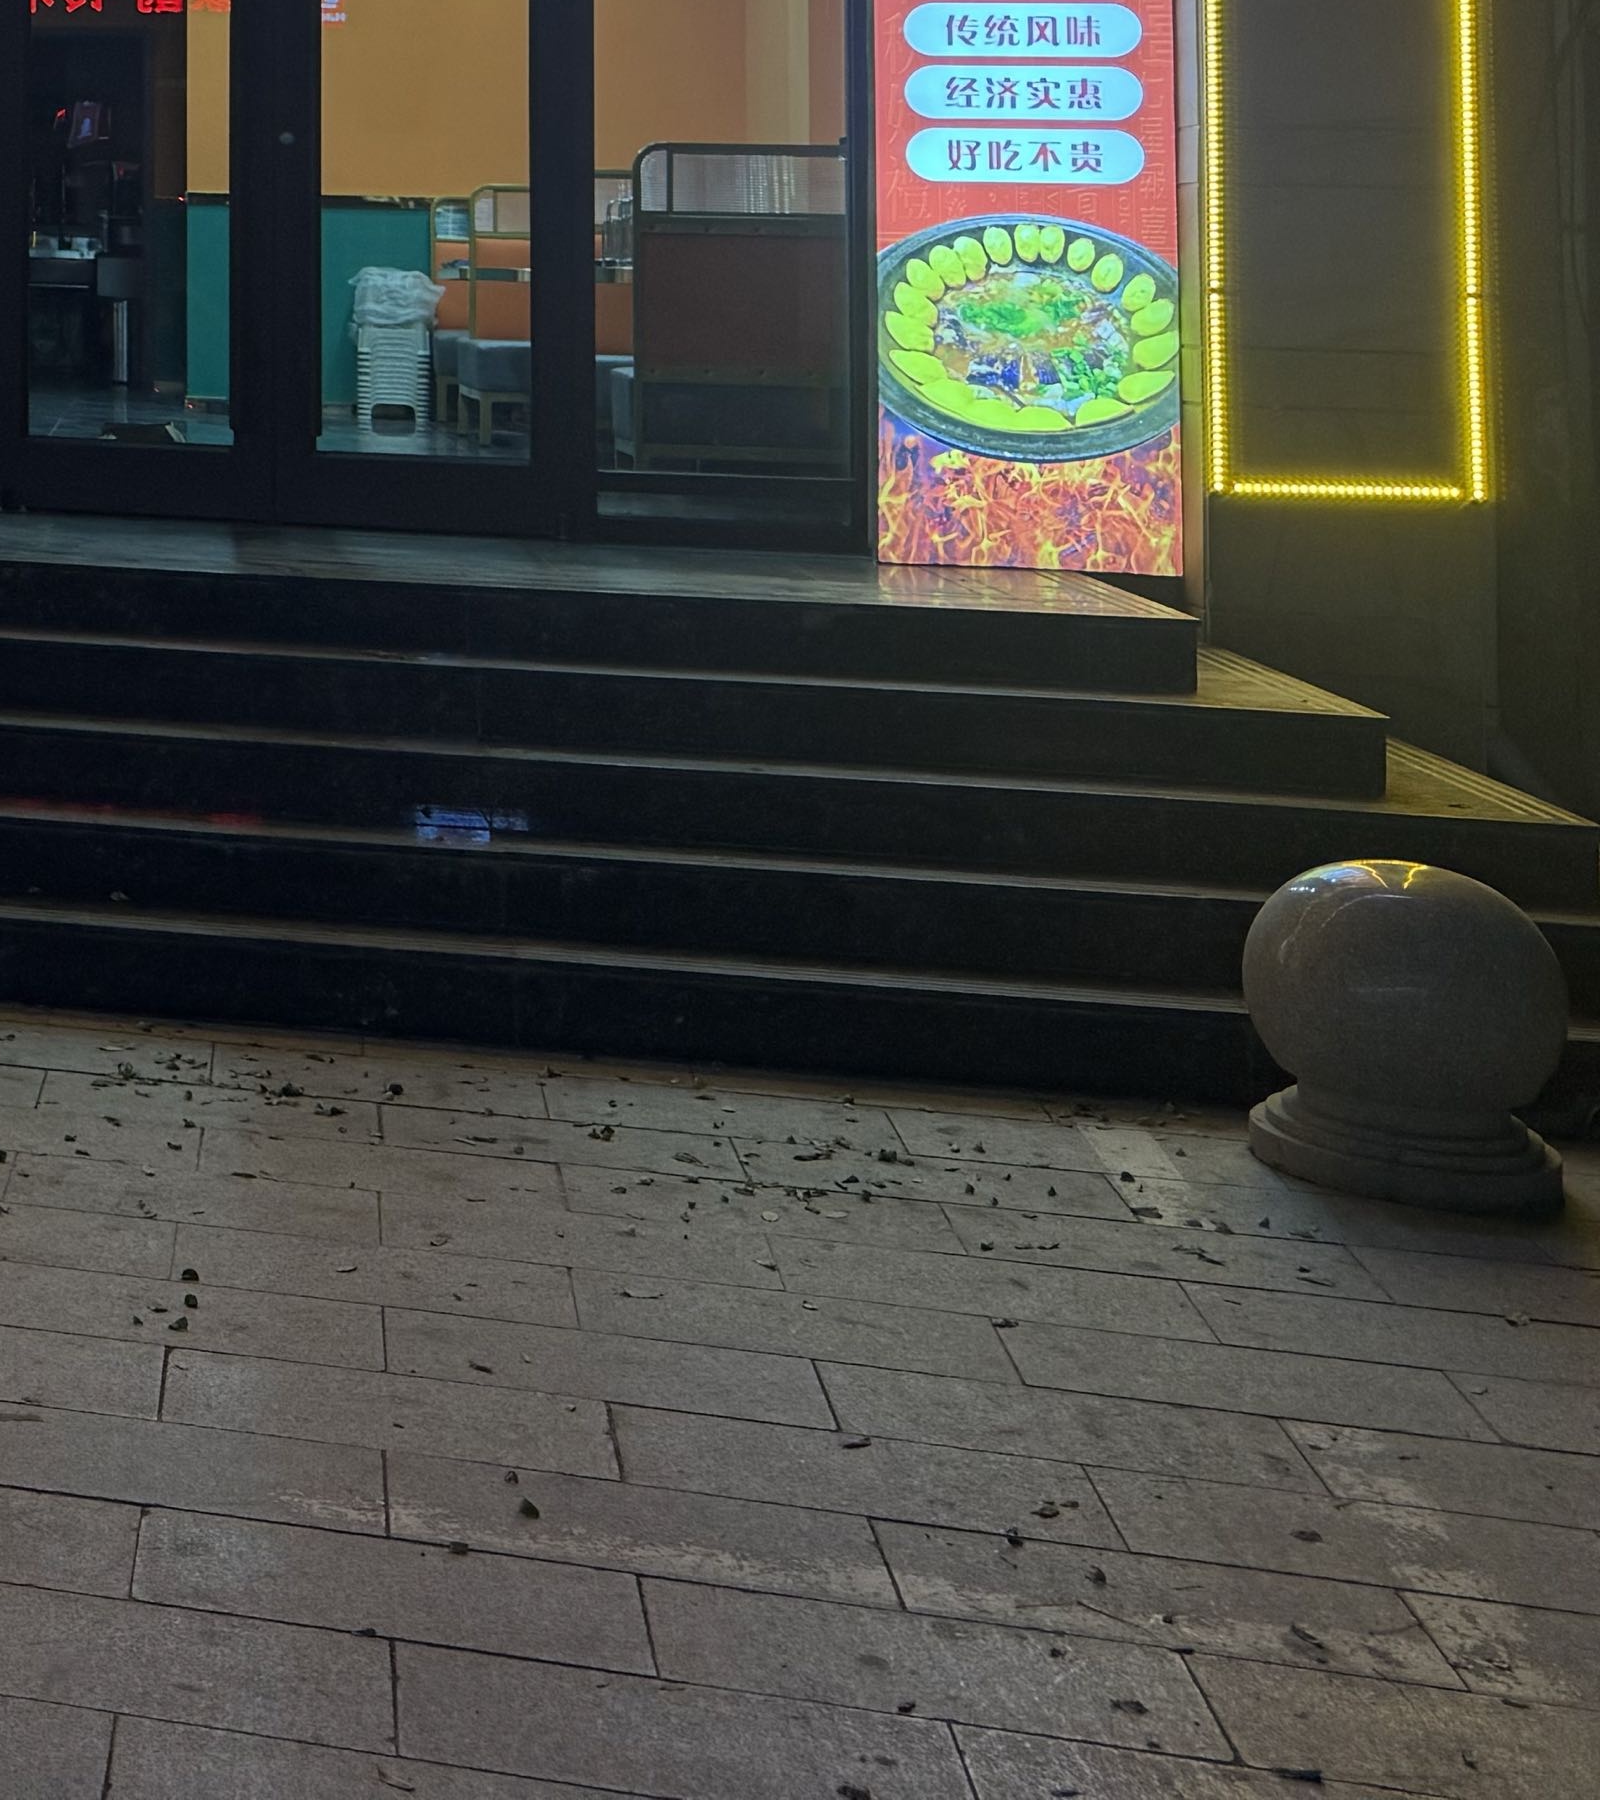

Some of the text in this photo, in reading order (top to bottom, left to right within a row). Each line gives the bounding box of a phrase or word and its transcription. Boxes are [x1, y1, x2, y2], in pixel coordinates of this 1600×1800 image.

[944, 14, 1102, 48] 传统风味
[944, 76, 1104, 110] 经济实惠
[946, 138, 1105, 174] 好吃不贵
